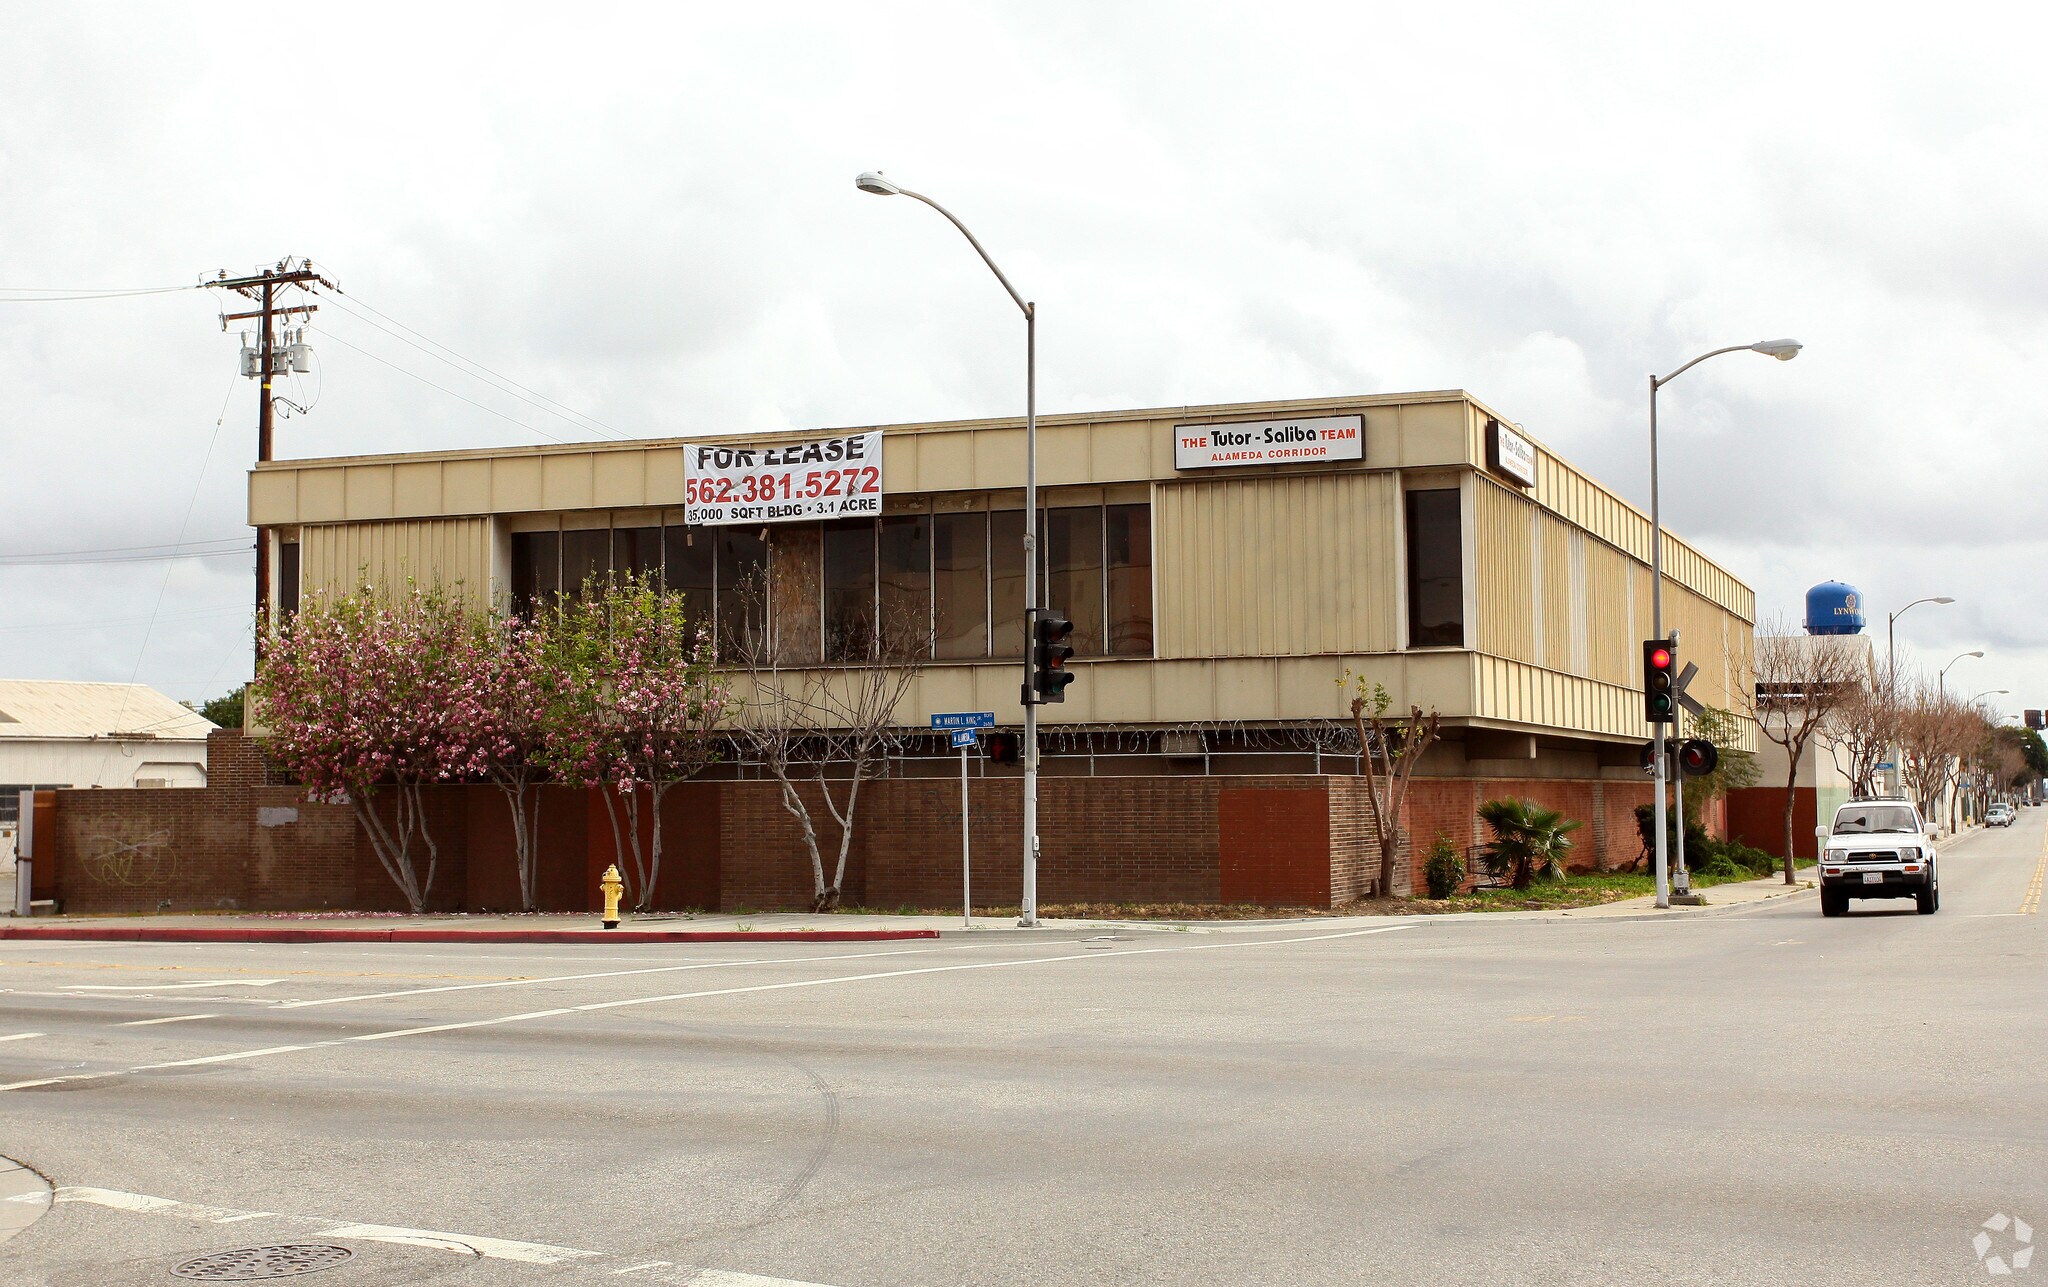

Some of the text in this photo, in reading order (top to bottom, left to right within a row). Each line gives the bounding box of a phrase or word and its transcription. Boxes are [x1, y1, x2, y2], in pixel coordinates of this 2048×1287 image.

[1182, 437, 1207, 449] THE
[1211, 430, 1251, 447] Tutor
[1264, 426, 1317, 444] Saliba
[1320, 428, 1356, 440] TEAM
[698, 434, 865, 470] FOR LEASE
[1211, 447, 1327, 462] ALAMEDA CORRIDOR
[686, 465, 880, 506] 562.381.5272
[688, 498, 877, 522] 35,000 SQFT BLDG 3.1 ACRE
